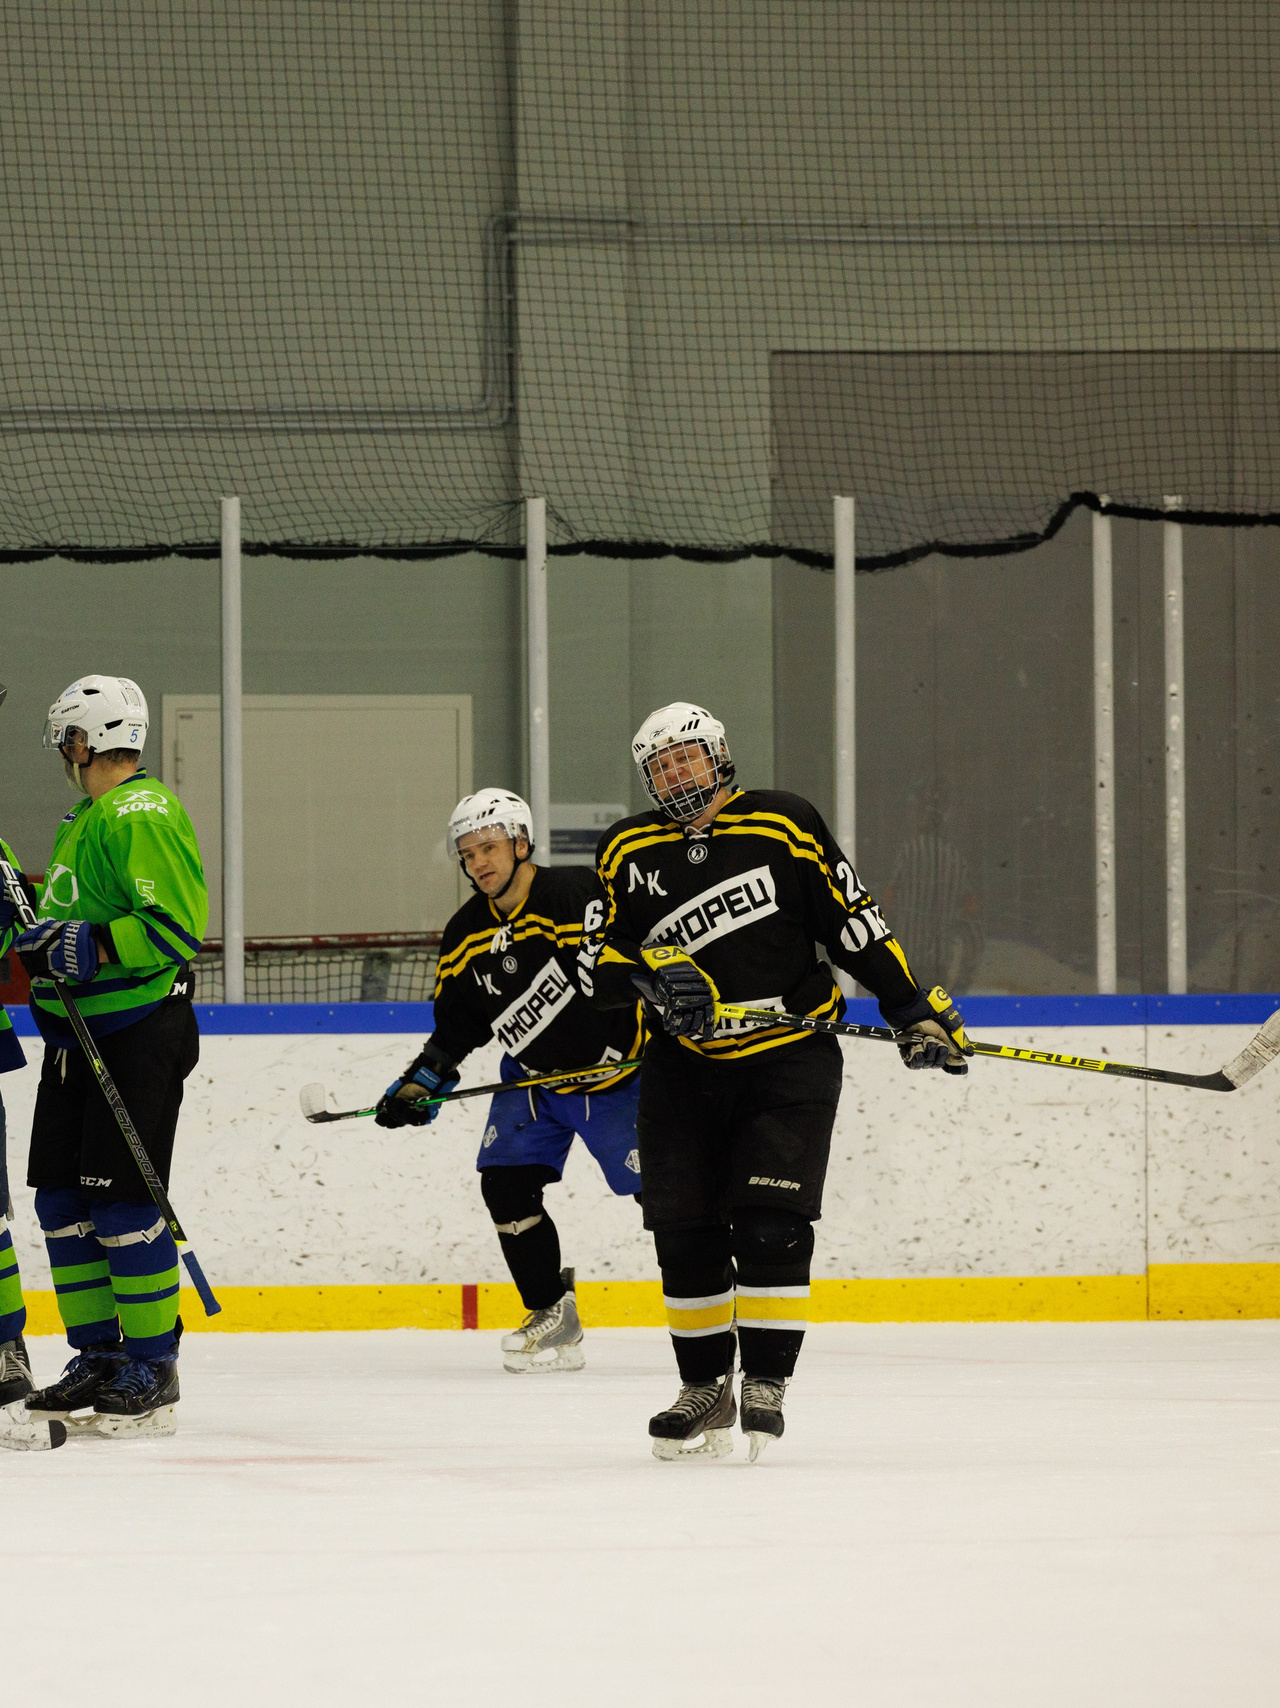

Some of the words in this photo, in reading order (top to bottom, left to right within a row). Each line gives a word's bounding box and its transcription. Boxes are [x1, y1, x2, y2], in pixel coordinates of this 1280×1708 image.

[61, 704, 80, 715] EASTON
[129, 728, 140, 743] 5
[583, 899, 604, 933] 6
[1005, 1046, 1102, 1070] TRUE
[748, 1175, 801, 1191] BAUER
